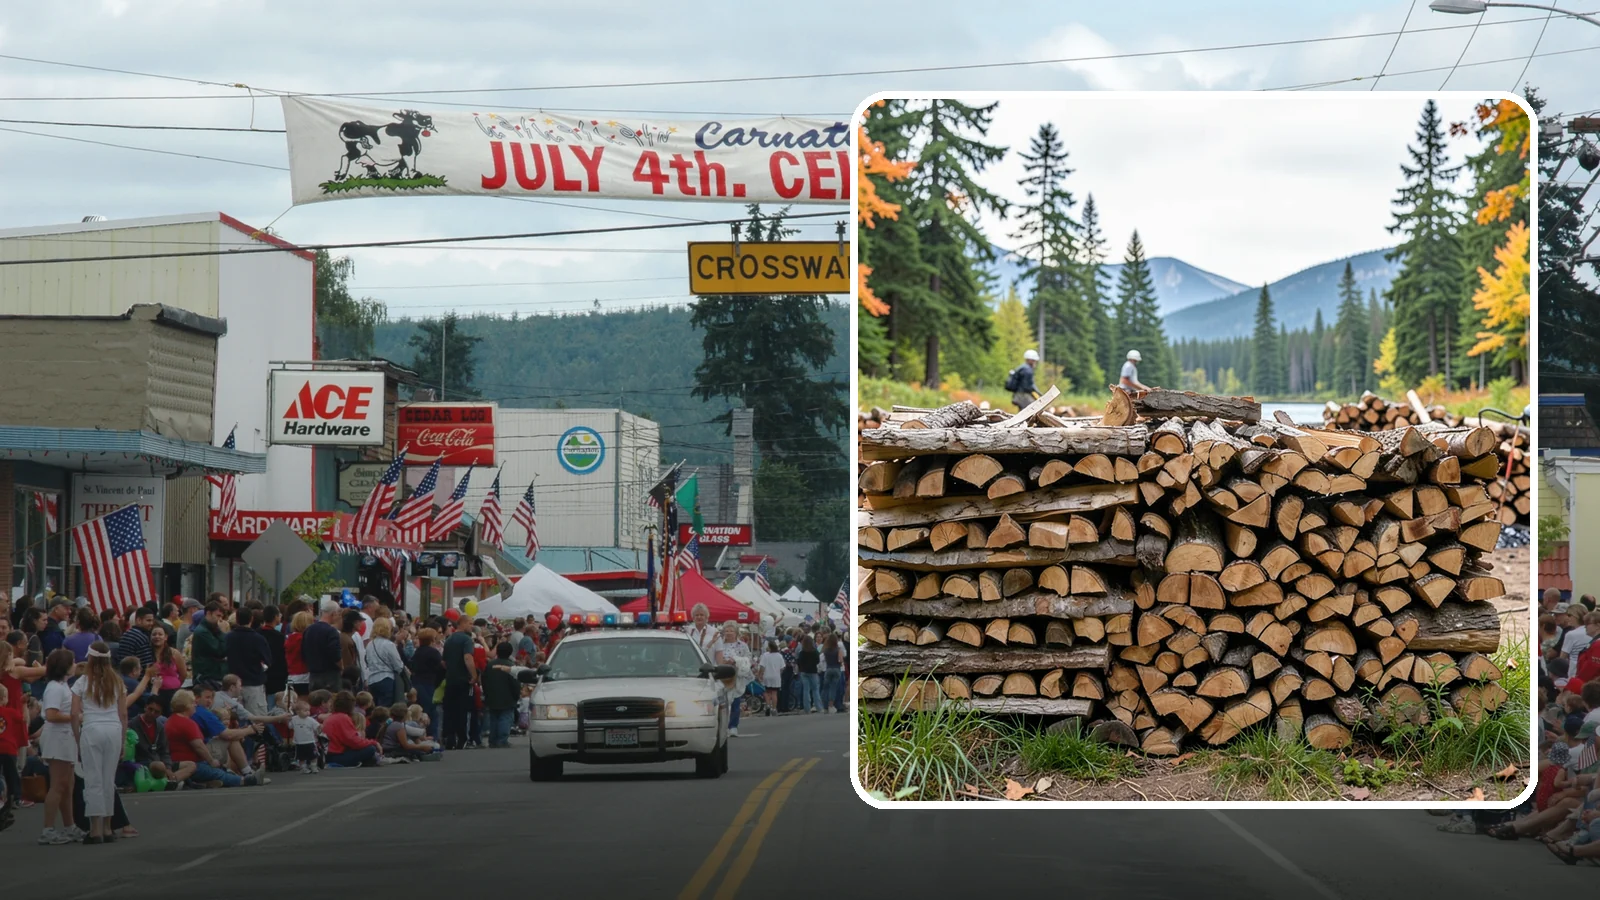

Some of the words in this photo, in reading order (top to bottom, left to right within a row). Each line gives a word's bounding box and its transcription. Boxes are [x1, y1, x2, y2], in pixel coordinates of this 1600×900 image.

[481, 141, 604, 193] JULY
[632, 150, 747, 198] 4th.
[697, 254, 850, 280] CROSSWA
[283, 380, 374, 420] ACE
[405, 409, 453, 422] CEDAR
[284, 421, 371, 437] Hardware
[416, 427, 477, 447] Coca-Cola
[353, 467, 385, 479] Simpl
[83, 484, 93, 495] St.
[95, 485, 124, 495] Vincent
[126, 485, 136, 495] de
[137, 486, 155, 496] Paul
[81, 503, 154, 522] THT
[212, 516, 331, 536] HARDARE
[688, 526, 741, 535] CRNATION
[699, 535, 730, 544] GLASS
